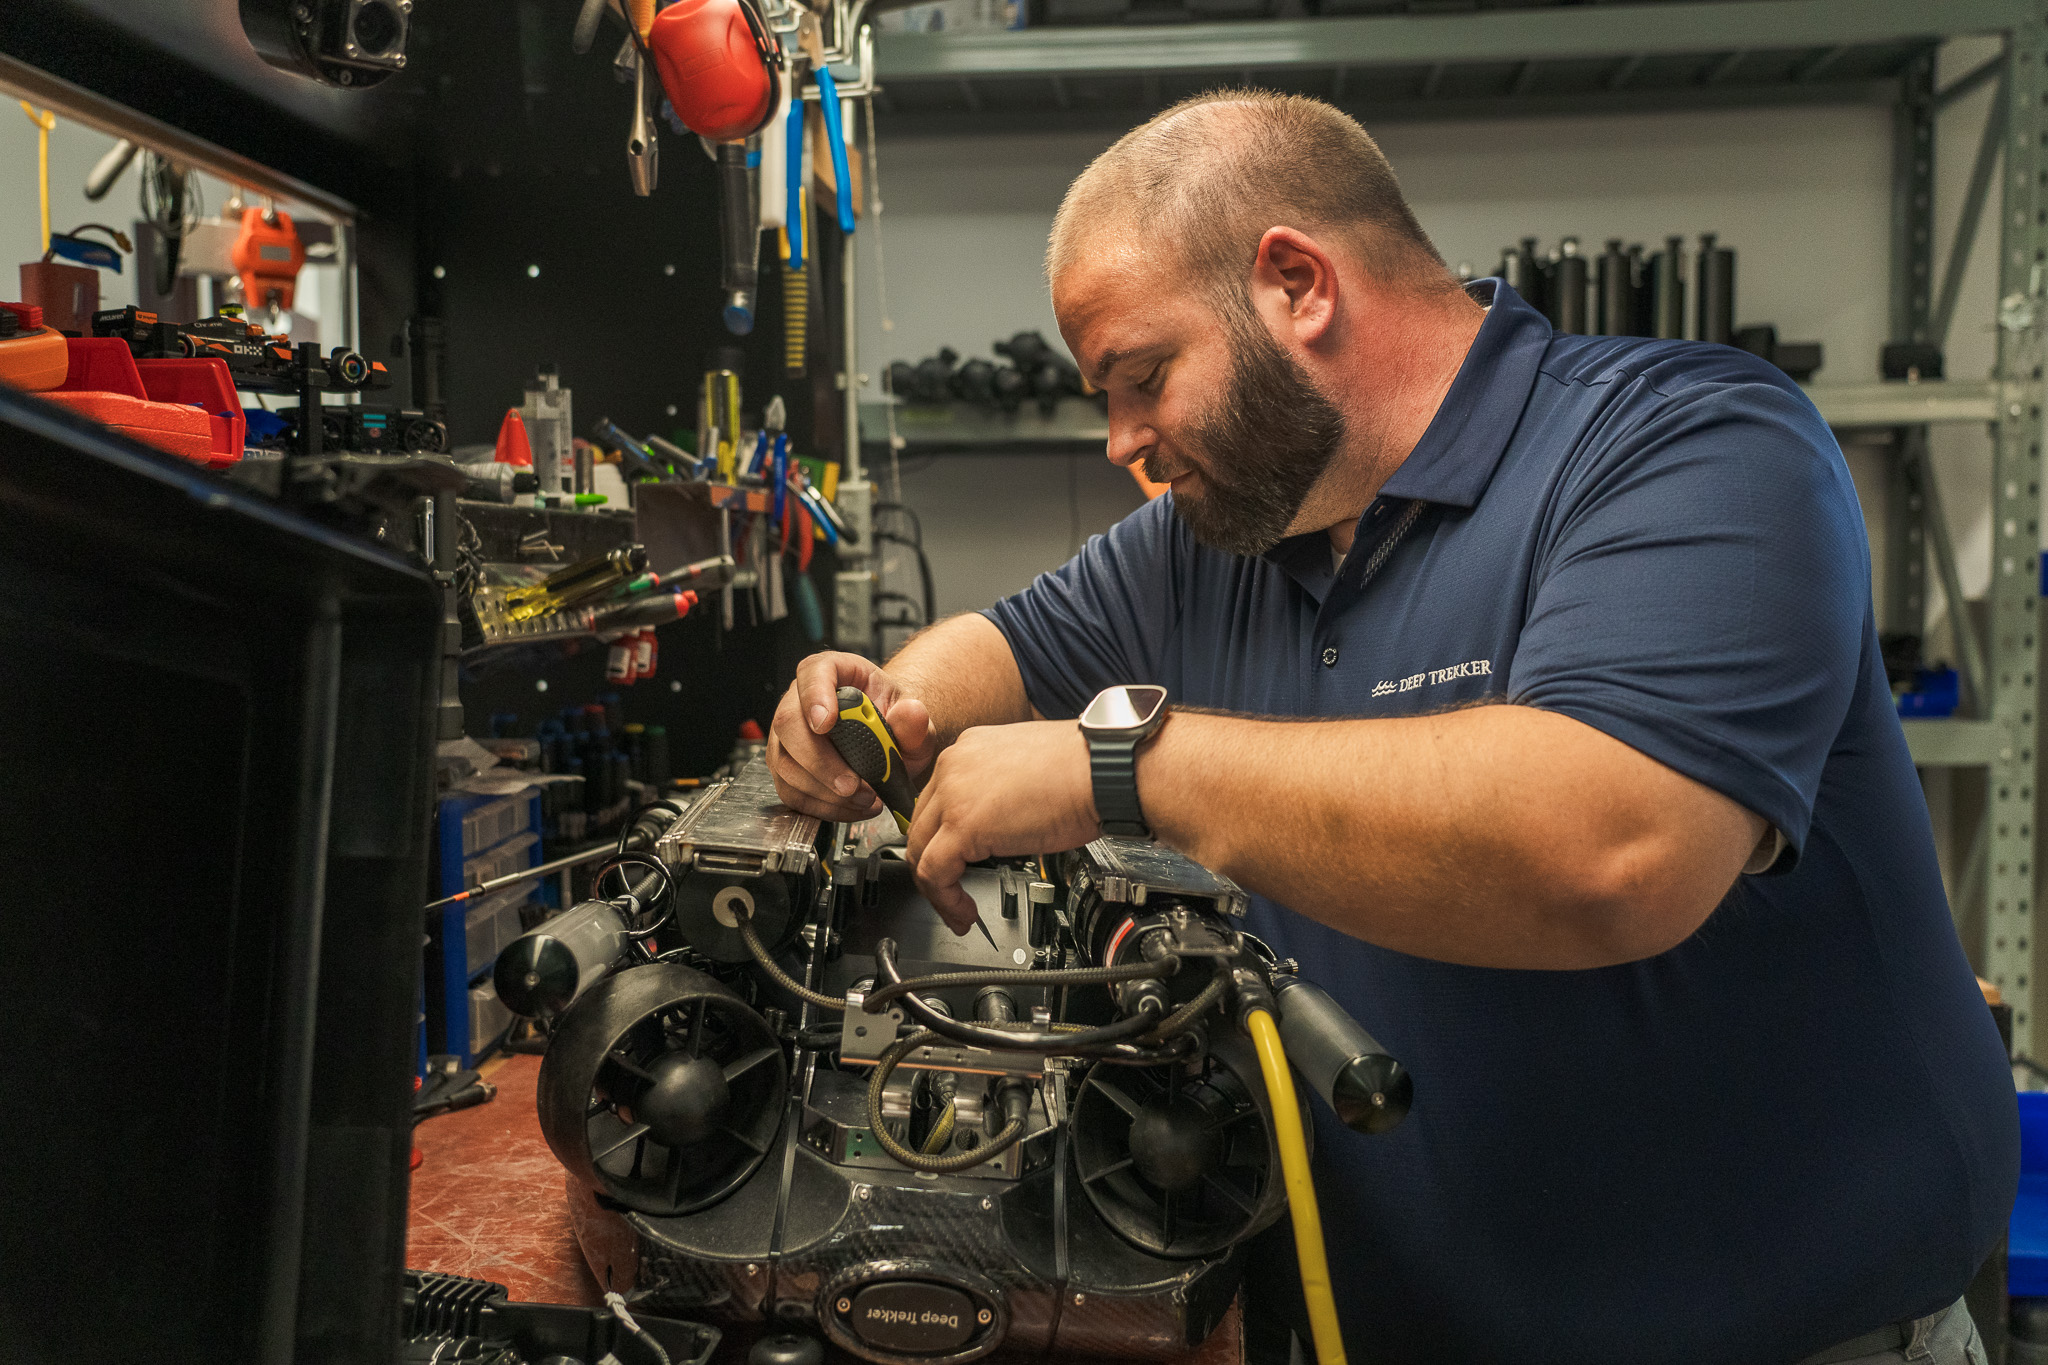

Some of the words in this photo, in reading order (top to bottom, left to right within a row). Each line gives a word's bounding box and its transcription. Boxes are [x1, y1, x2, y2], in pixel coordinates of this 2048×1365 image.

[233, 344, 263, 356] OKX
[1399, 673, 1426, 692] DEEP
[1428, 659, 1492, 685] TREKKER
[866, 1308, 917, 1325] Trekker
[921, 1310, 958, 1328] Deep
